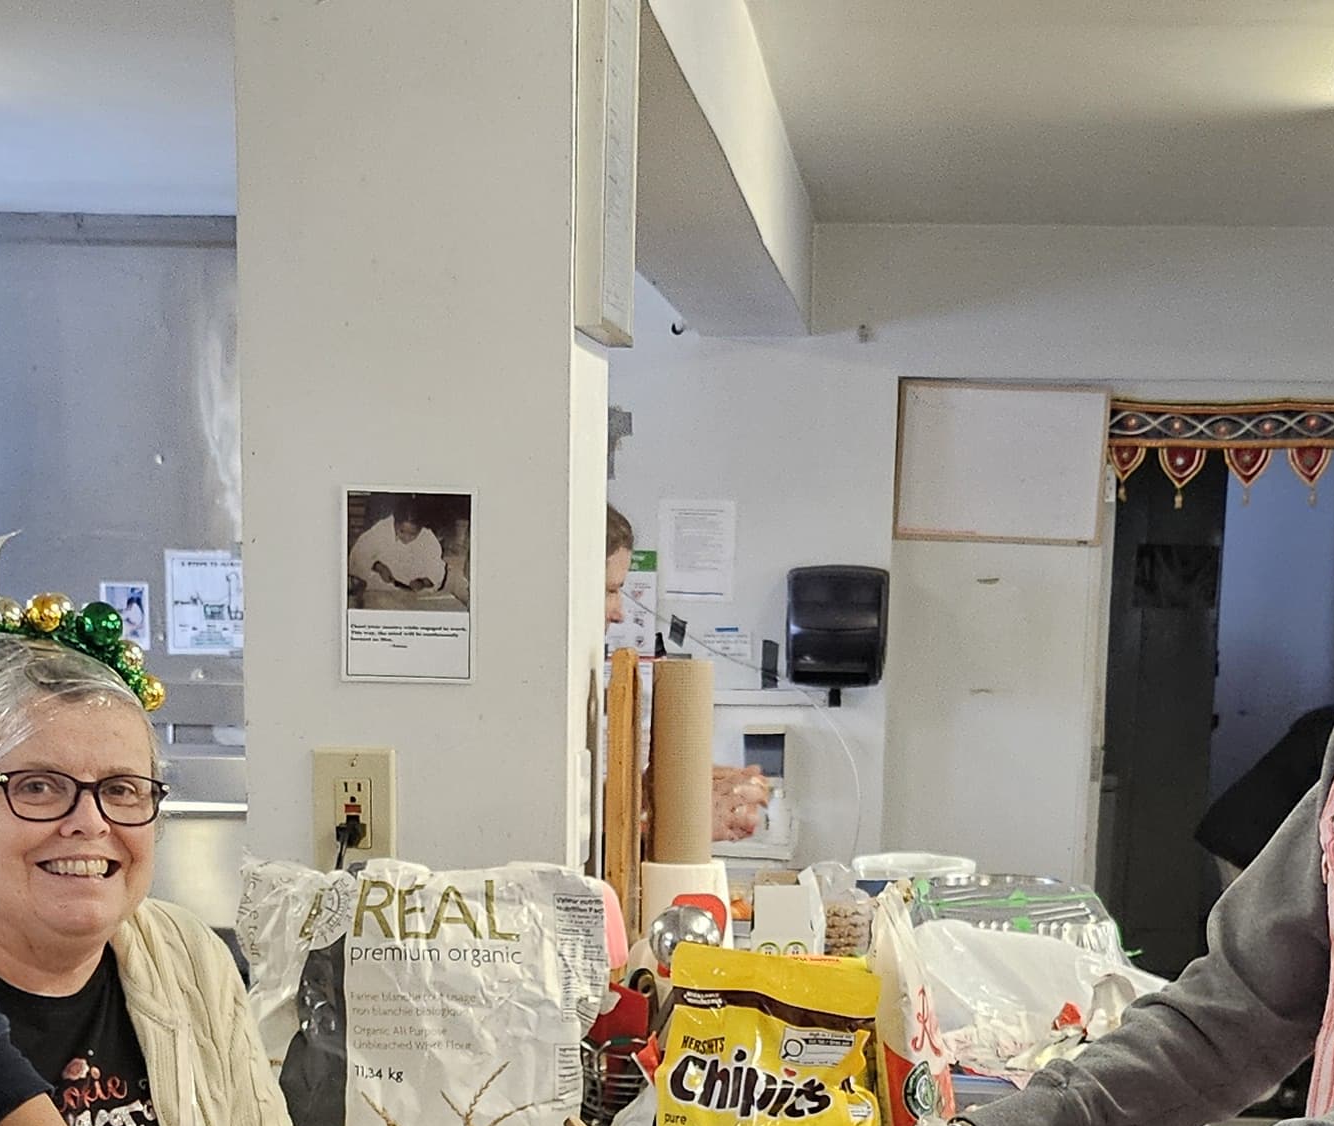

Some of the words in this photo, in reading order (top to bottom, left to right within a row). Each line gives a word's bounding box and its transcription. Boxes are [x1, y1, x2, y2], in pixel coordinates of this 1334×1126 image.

[350, 945, 440, 965] premium
[448, 945, 523, 967] organic
[353, 1040, 413, 1050] Unbleached
[388, 1065, 404, 1083] kg
[670, 1048, 831, 1118] Chipits
[664, 1112, 687, 1125] pure
